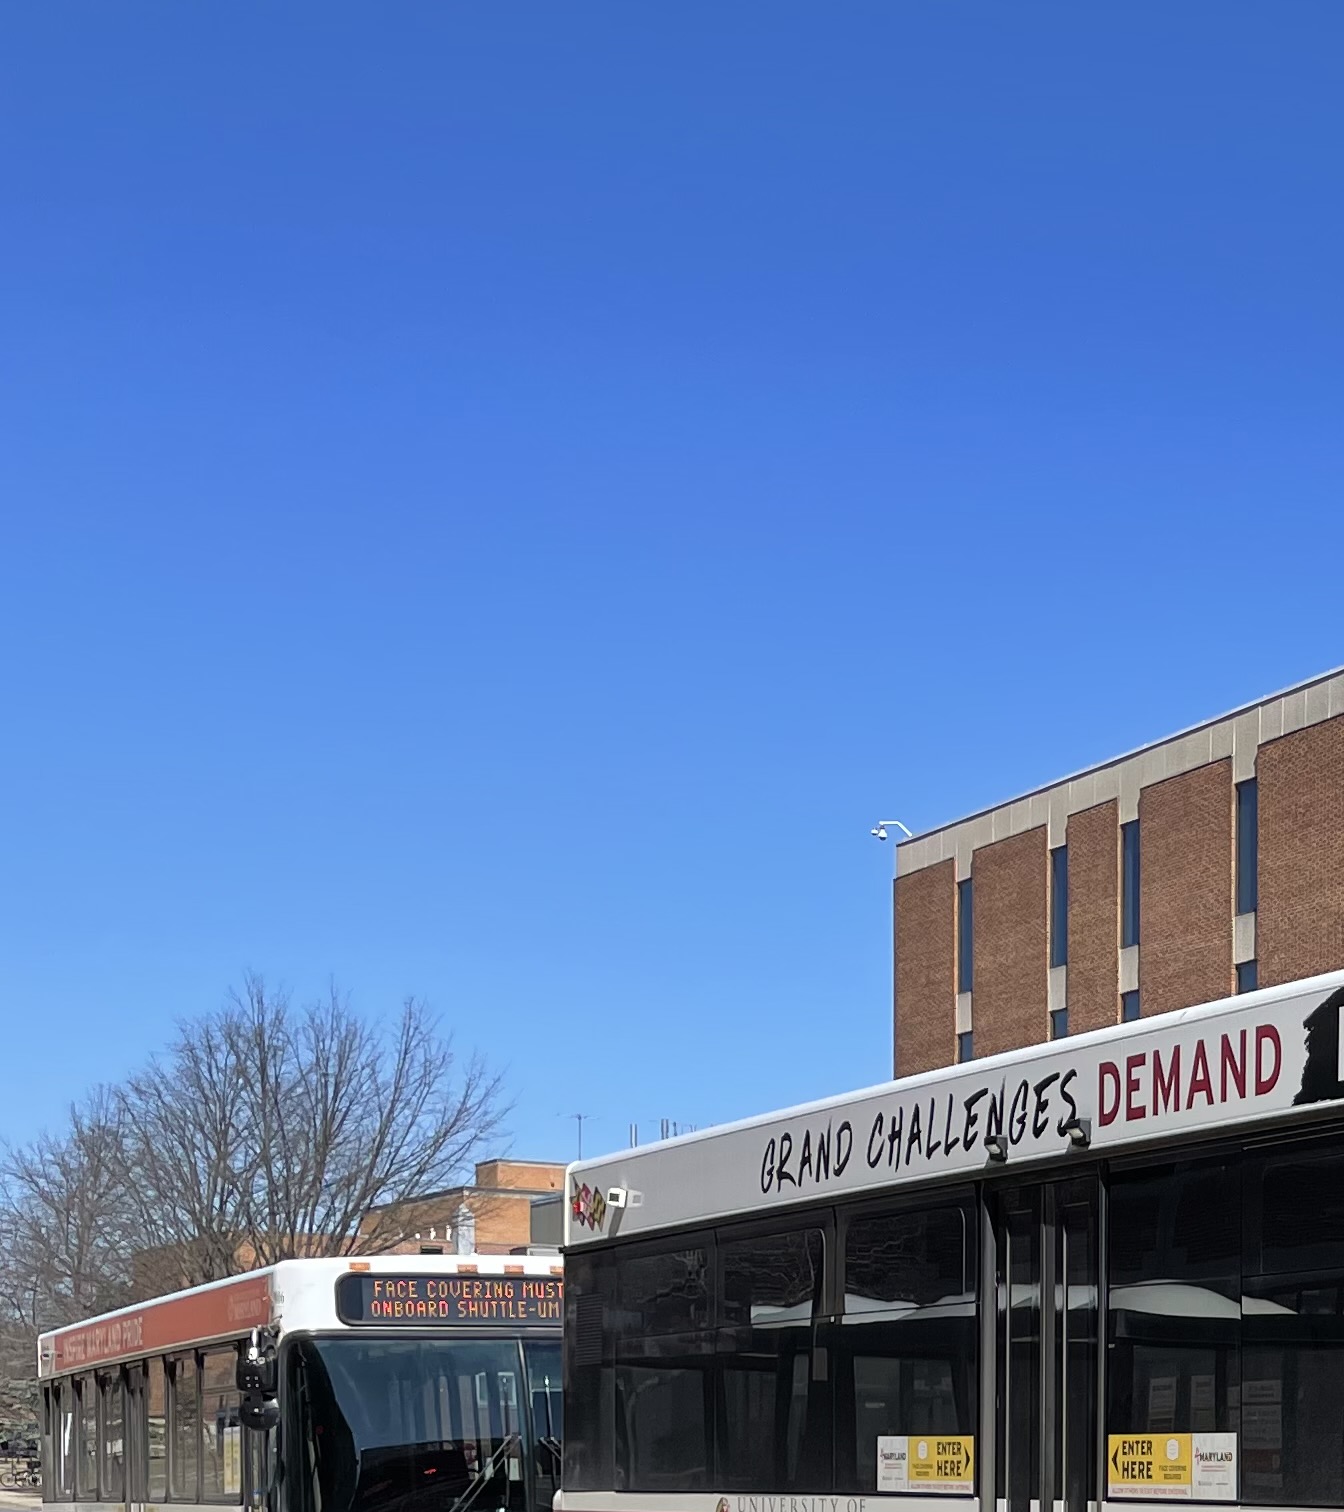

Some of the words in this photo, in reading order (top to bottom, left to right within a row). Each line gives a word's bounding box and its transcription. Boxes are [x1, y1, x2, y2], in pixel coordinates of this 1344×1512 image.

[760, 1116, 854, 1194] GRAND
[867, 1069, 1079, 1173] CHALLENGES
[1098, 1023, 1282, 1128] DEMAND
[373, 1280, 418, 1298] FACE
[427, 1280, 514, 1299] COVERING
[522, 1281, 564, 1299] MUST
[371, 1300, 449, 1318] ONBOARD
[457, 1300, 560, 1319] SHUTTLE-UM
[937, 1441, 962, 1455] ENTER
[1122, 1440, 1152, 1455] ENTER
[937, 1459, 962, 1477] HERE
[1122, 1461, 1152, 1479] HERE
